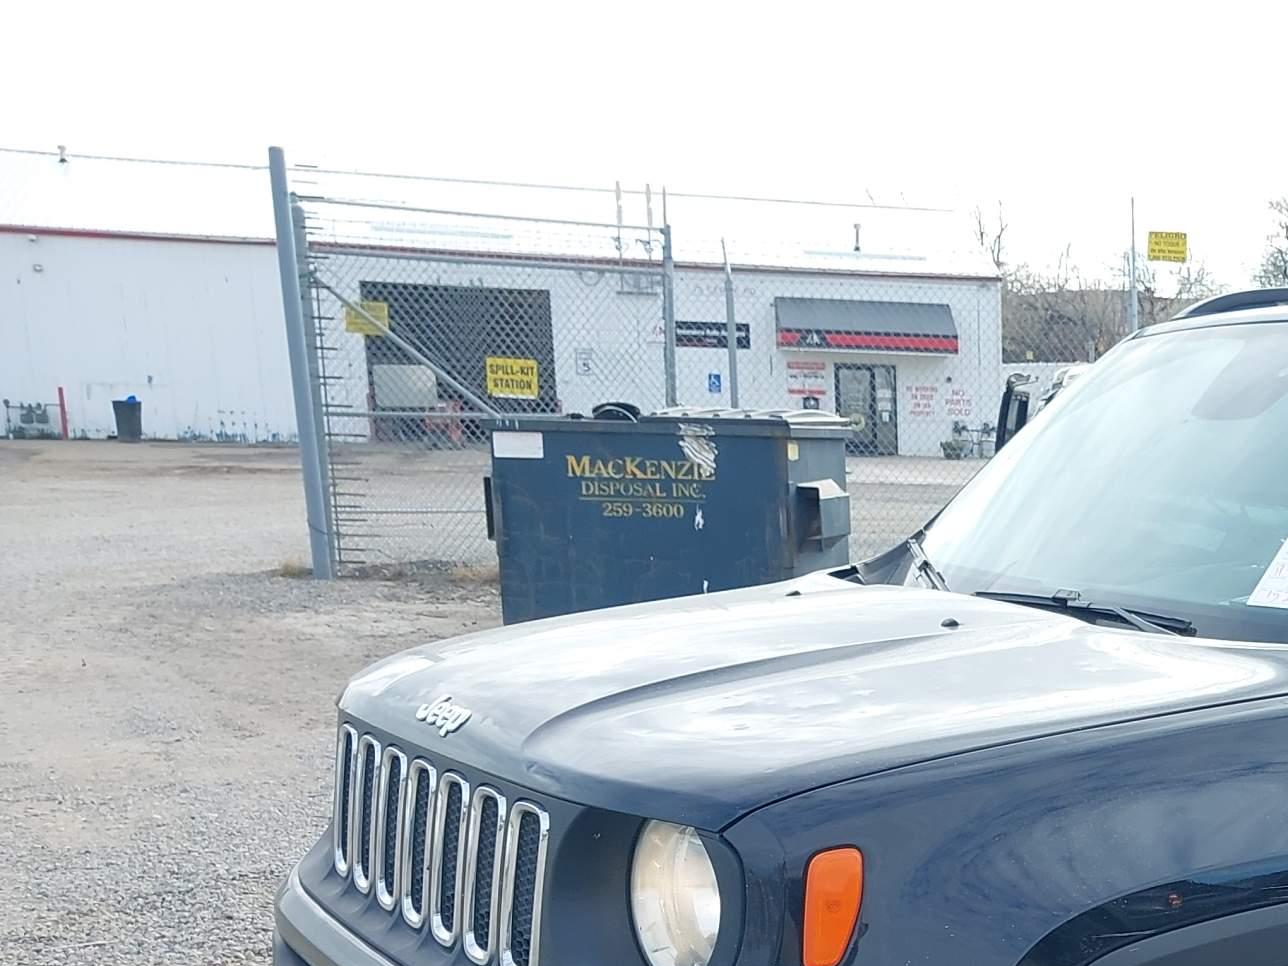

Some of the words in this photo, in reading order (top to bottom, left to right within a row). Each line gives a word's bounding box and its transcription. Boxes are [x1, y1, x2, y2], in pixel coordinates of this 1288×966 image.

[489, 364, 534, 376] SPILL-KIT
[493, 378, 532, 390] STATION
[581, 481, 666, 498] DISPOSAL
[603, 502, 684, 519] 259-3600
[416, 694, 472, 738] Jeep
